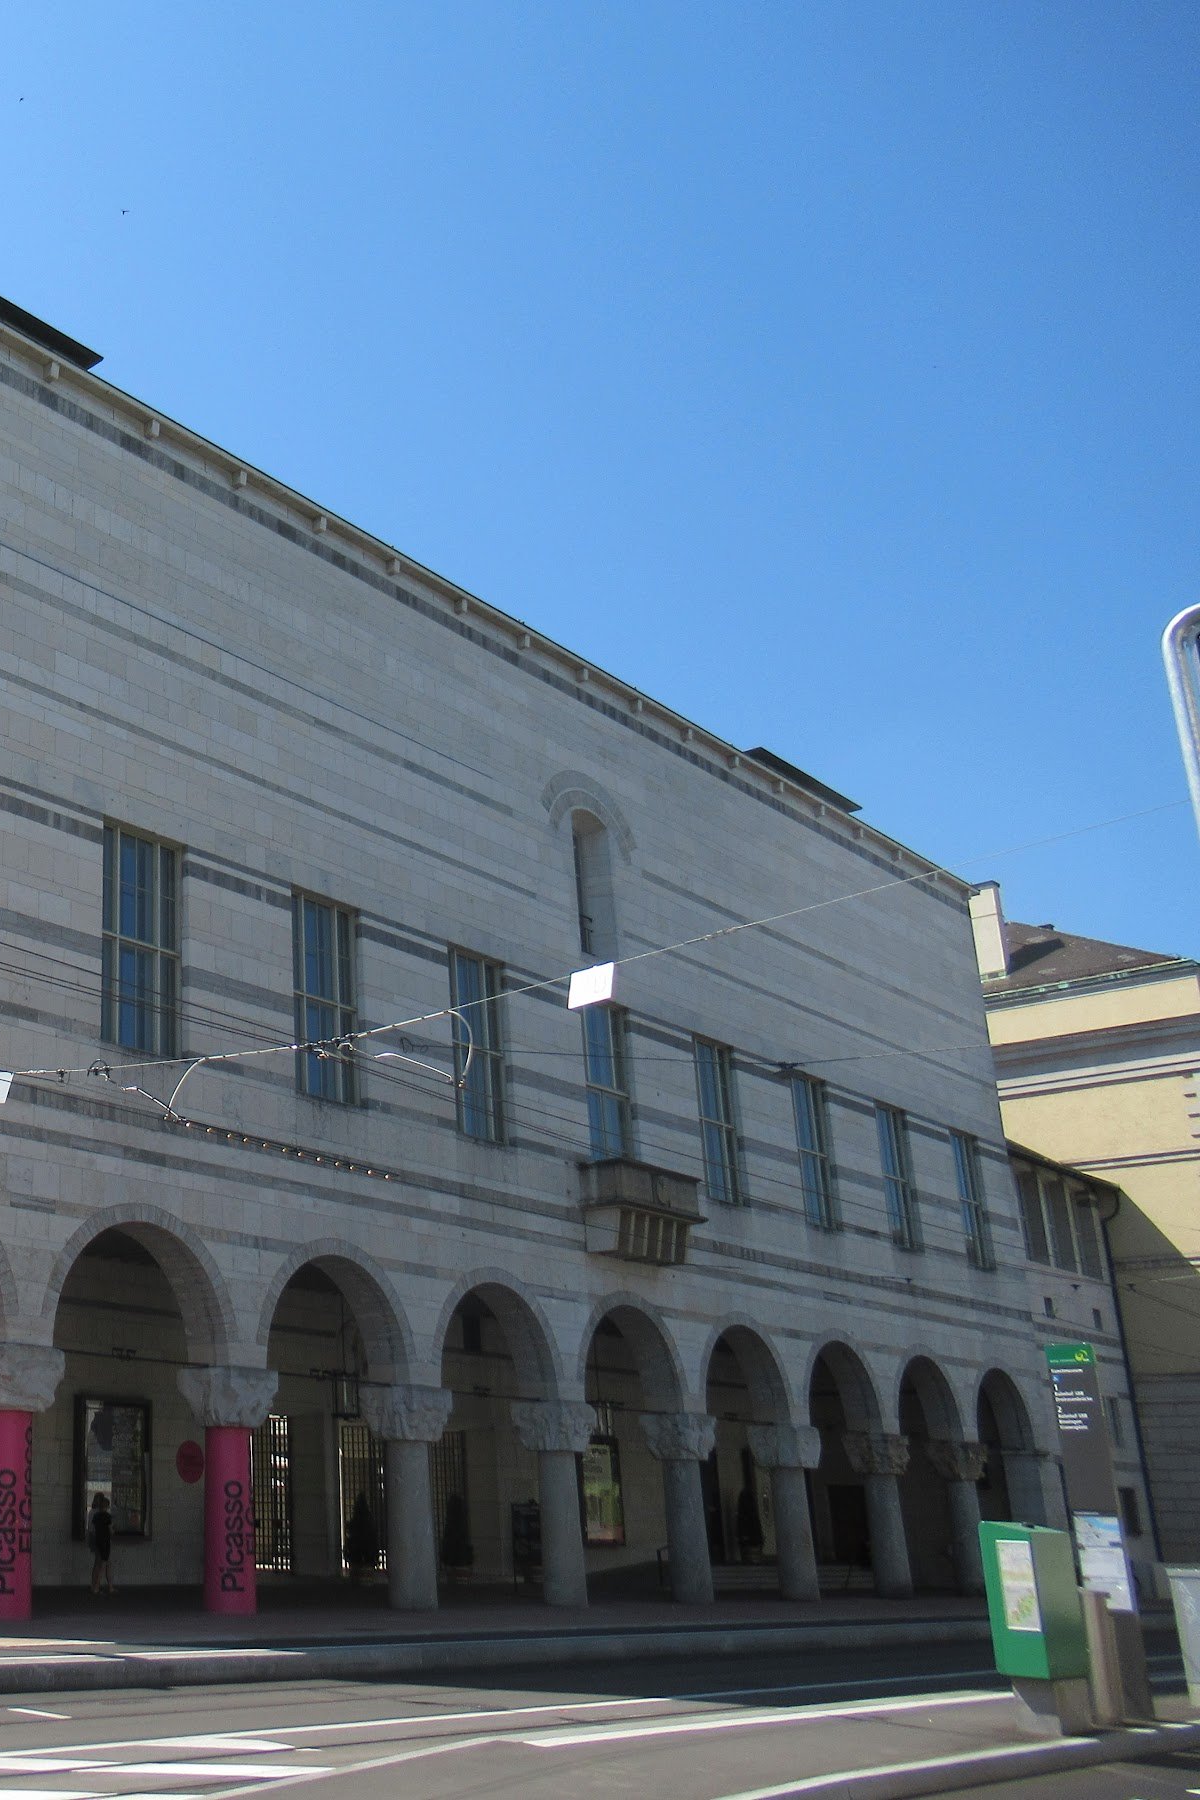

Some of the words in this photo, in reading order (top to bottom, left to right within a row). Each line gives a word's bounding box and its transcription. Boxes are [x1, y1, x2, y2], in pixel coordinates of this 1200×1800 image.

[1053, 1383, 1059, 1391] 1
[1056, 1405, 1063, 1413] 2
[220, 1479, 245, 1593] Picasso
